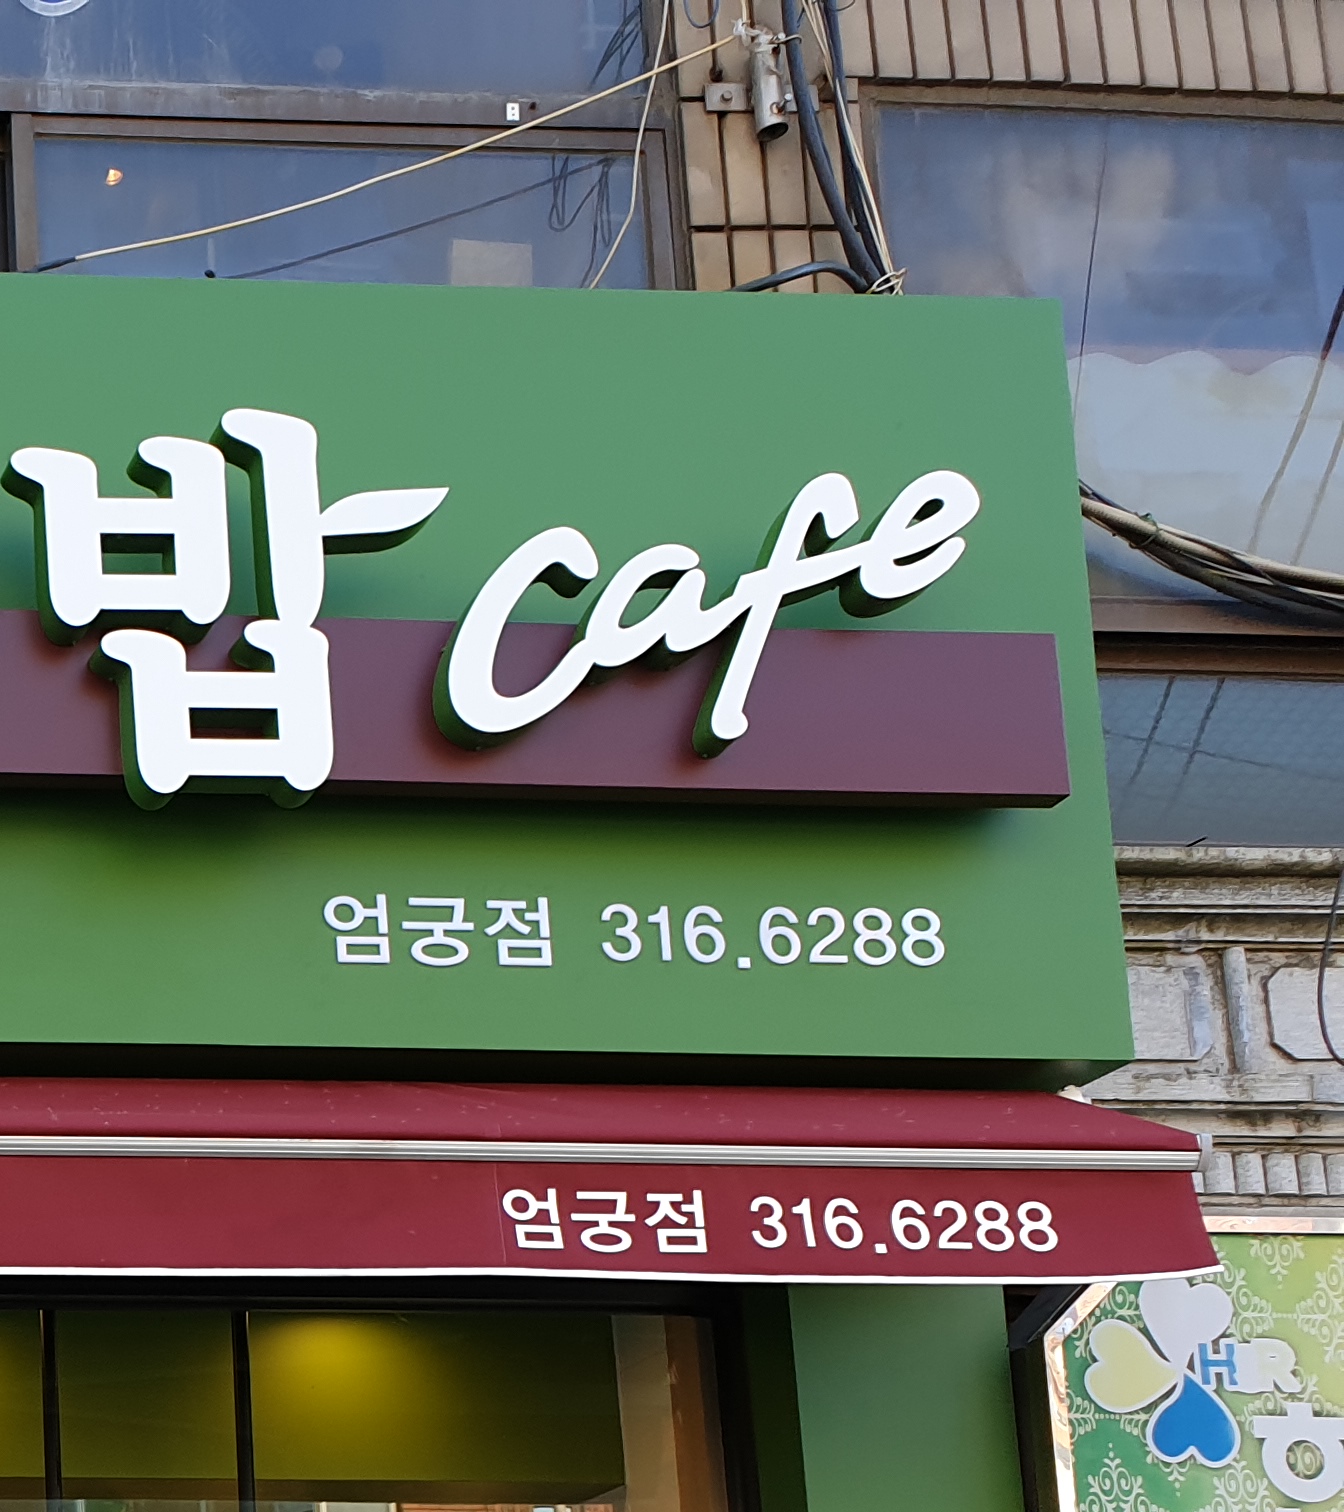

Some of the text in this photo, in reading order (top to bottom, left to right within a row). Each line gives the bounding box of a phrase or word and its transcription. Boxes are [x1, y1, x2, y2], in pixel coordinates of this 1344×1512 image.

[447, 468, 980, 742] cafe
[323, 895, 946, 968] 엄궁점 316.6288
[501, 1187, 1060, 1256] 엄궁점 316.6288
